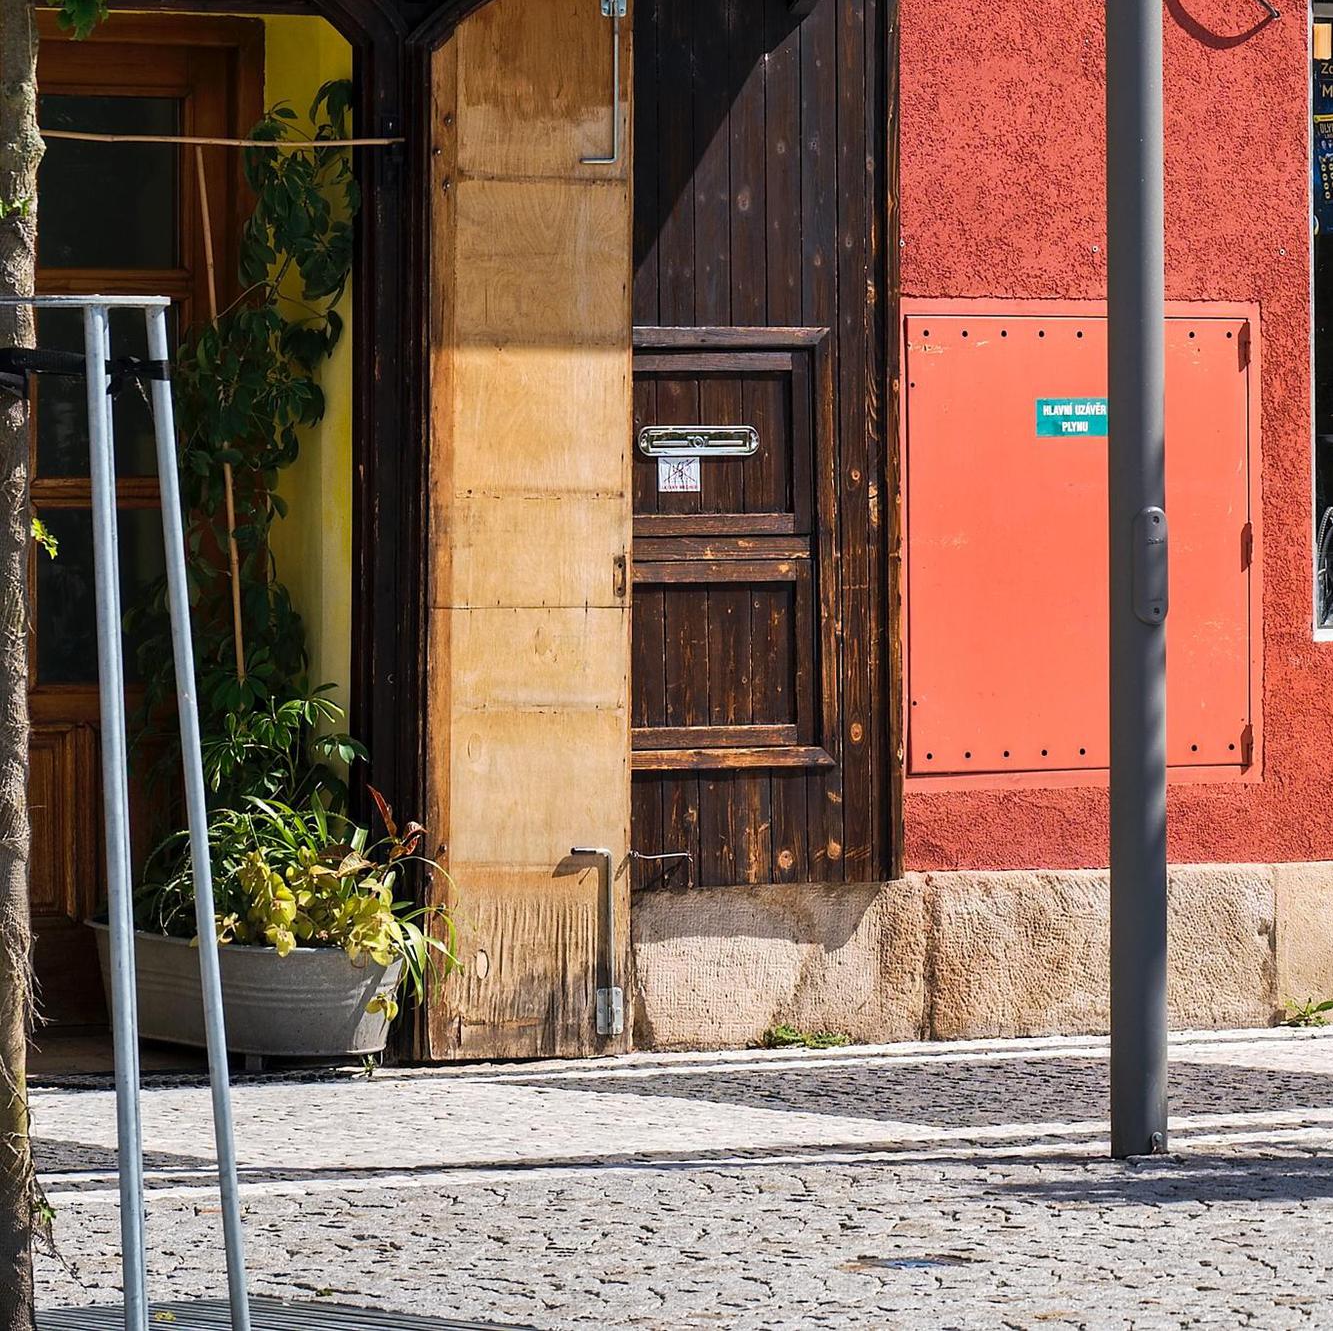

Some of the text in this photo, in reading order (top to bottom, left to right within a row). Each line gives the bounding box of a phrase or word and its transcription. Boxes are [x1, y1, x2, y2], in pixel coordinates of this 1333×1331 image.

[1043, 401, 1107, 416] HLAVNÍ UZÁVĚR
[1061, 421, 1089, 432] PLYNU
